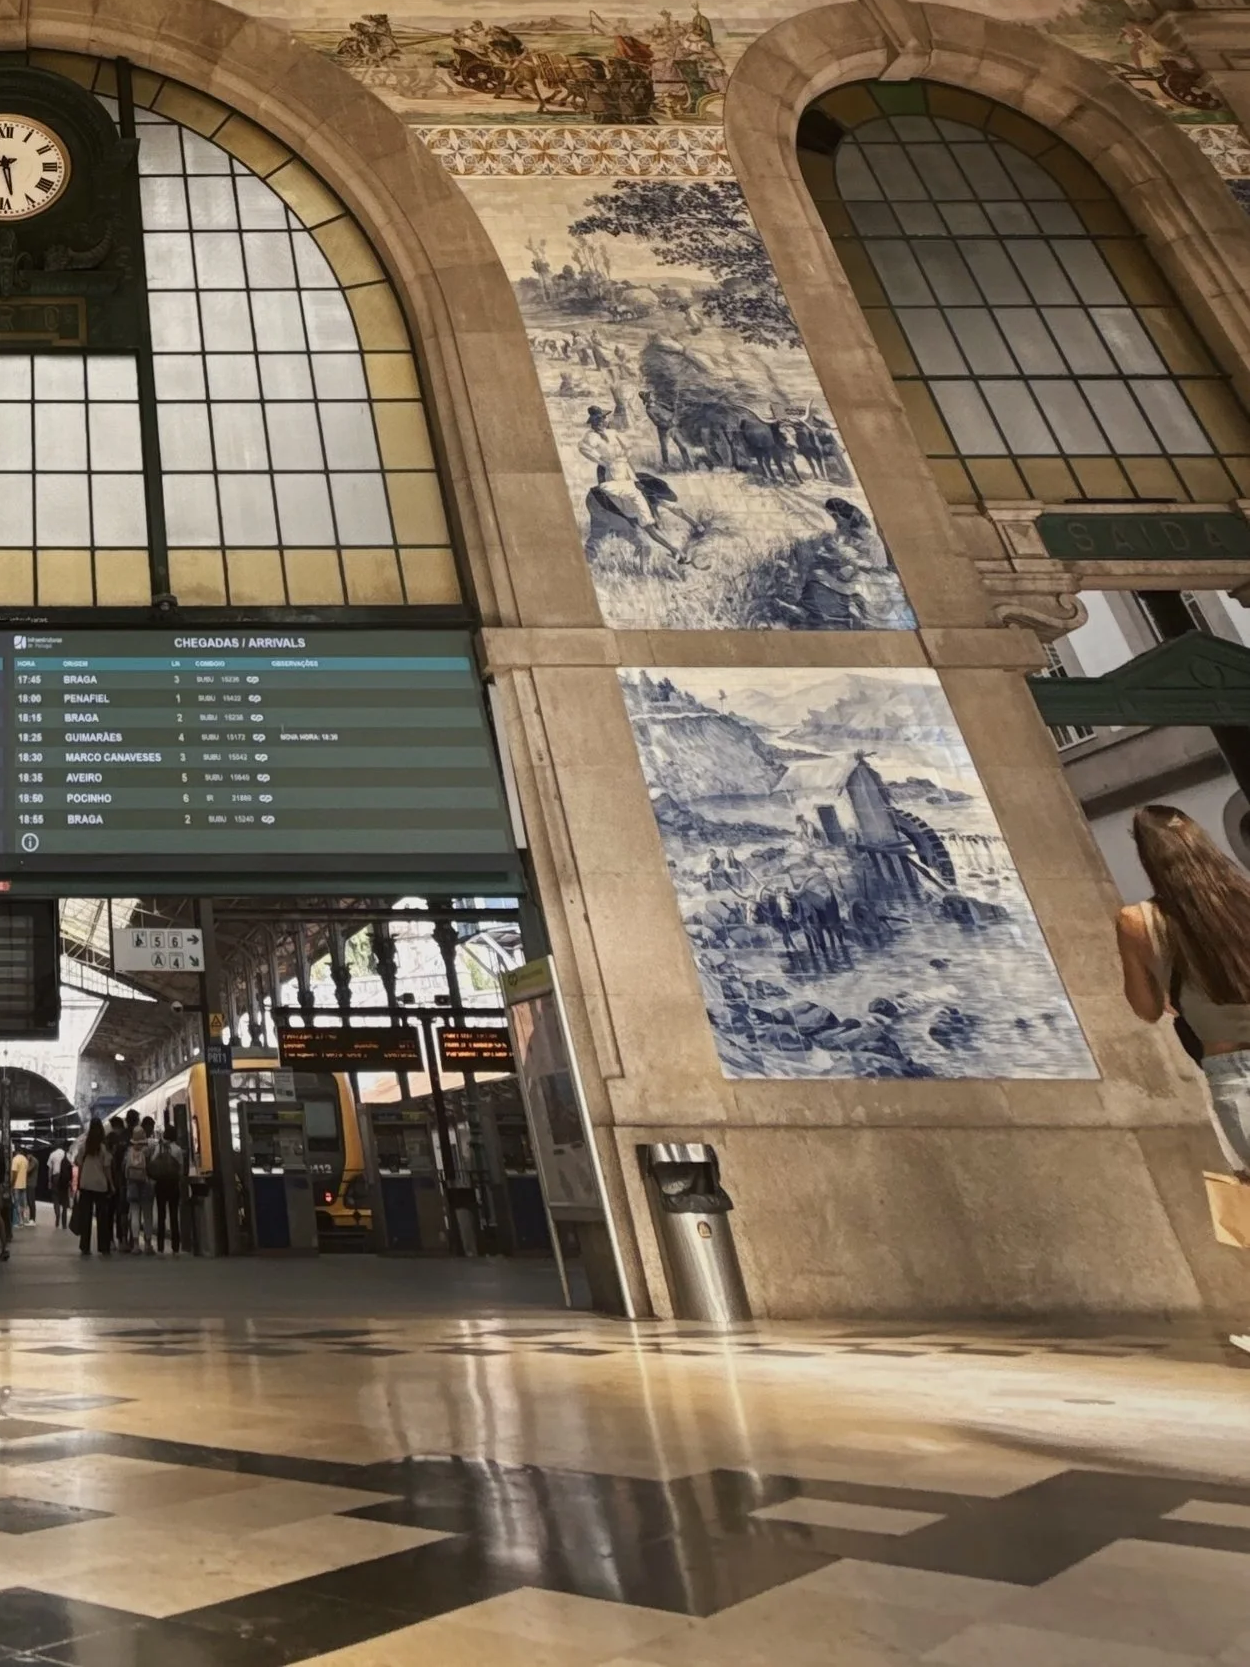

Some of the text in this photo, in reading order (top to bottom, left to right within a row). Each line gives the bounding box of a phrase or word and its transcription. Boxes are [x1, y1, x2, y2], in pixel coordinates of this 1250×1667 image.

[36, 144, 52, 156] II
[42, 162, 57, 172] III
[24, 193, 36, 205] V
[174, 637, 239, 648] CHEGADAS
[248, 637, 305, 648] ARRIVALS
[271, 659, 318, 668] OBSERVAÇÕES
[18, 675, 41, 684] 17:45
[63, 675, 97, 684] BRAGA
[18, 694, 41, 703] 18:00
[64, 694, 109, 703] PENAFIEL
[18, 713, 42, 722] 18:15
[64, 713, 99, 722] BRAGA
[65, 731, 122, 742] GUIMARÃES
[18, 753, 43, 762] 18:30
[66, 753, 101, 762] MARCO
[104, 753, 162, 762] CANAVESES
[18, 773, 43, 783] 18:35
[66, 773, 102, 783] AVEIRO
[67, 794, 112, 803] POCINHO
[68, 814, 103, 824] BRAGA
[154, 937, 178, 947] 5 6
[154, 955, 179, 968] A 4
